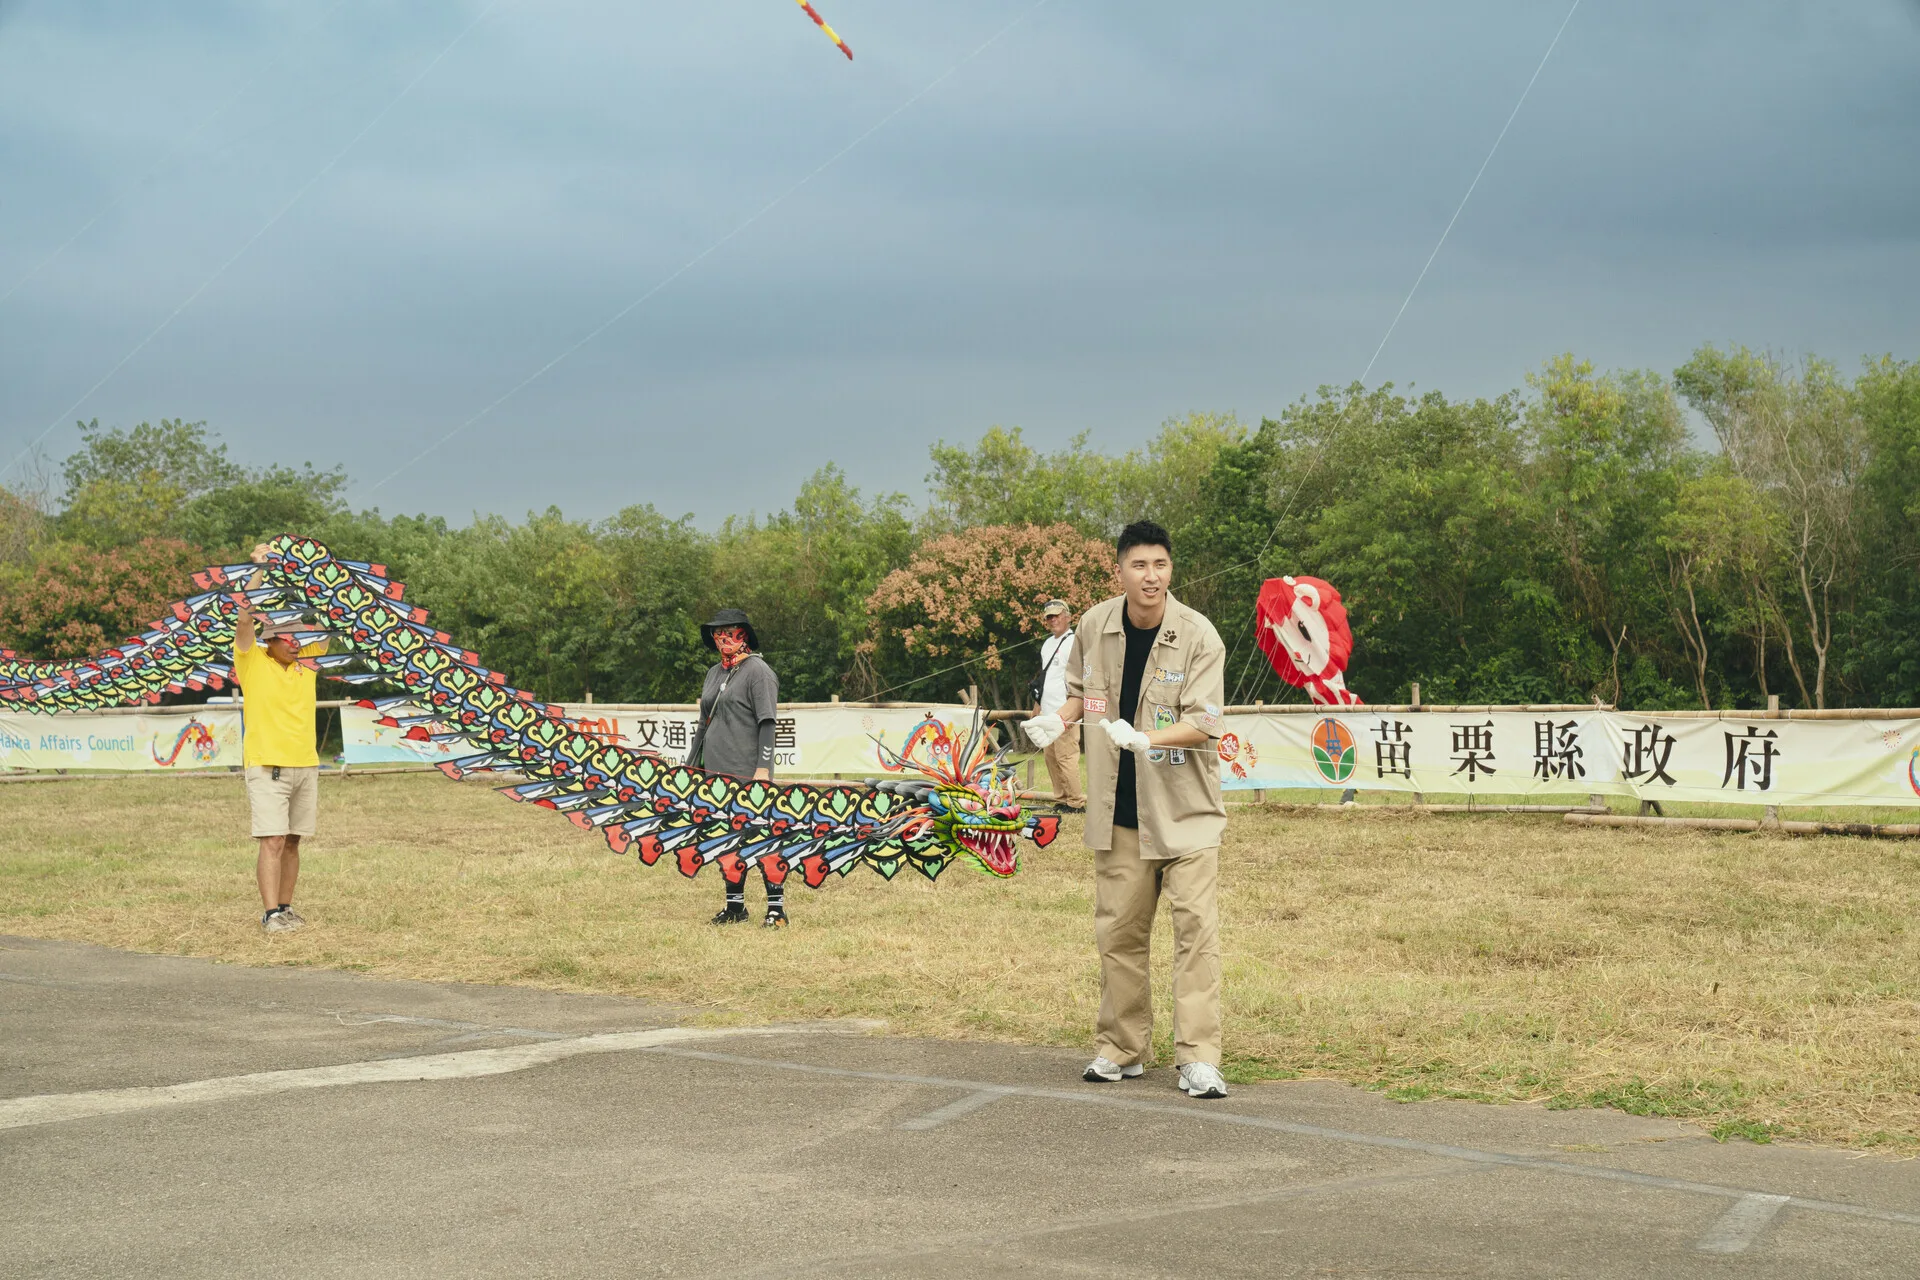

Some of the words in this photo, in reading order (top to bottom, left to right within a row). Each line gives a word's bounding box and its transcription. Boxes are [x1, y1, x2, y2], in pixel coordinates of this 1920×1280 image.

[40, 735, 82, 750] Affairs
[88, 735, 134, 751] Council
[1370, 719, 1781, 792] 苗栗縣政府
